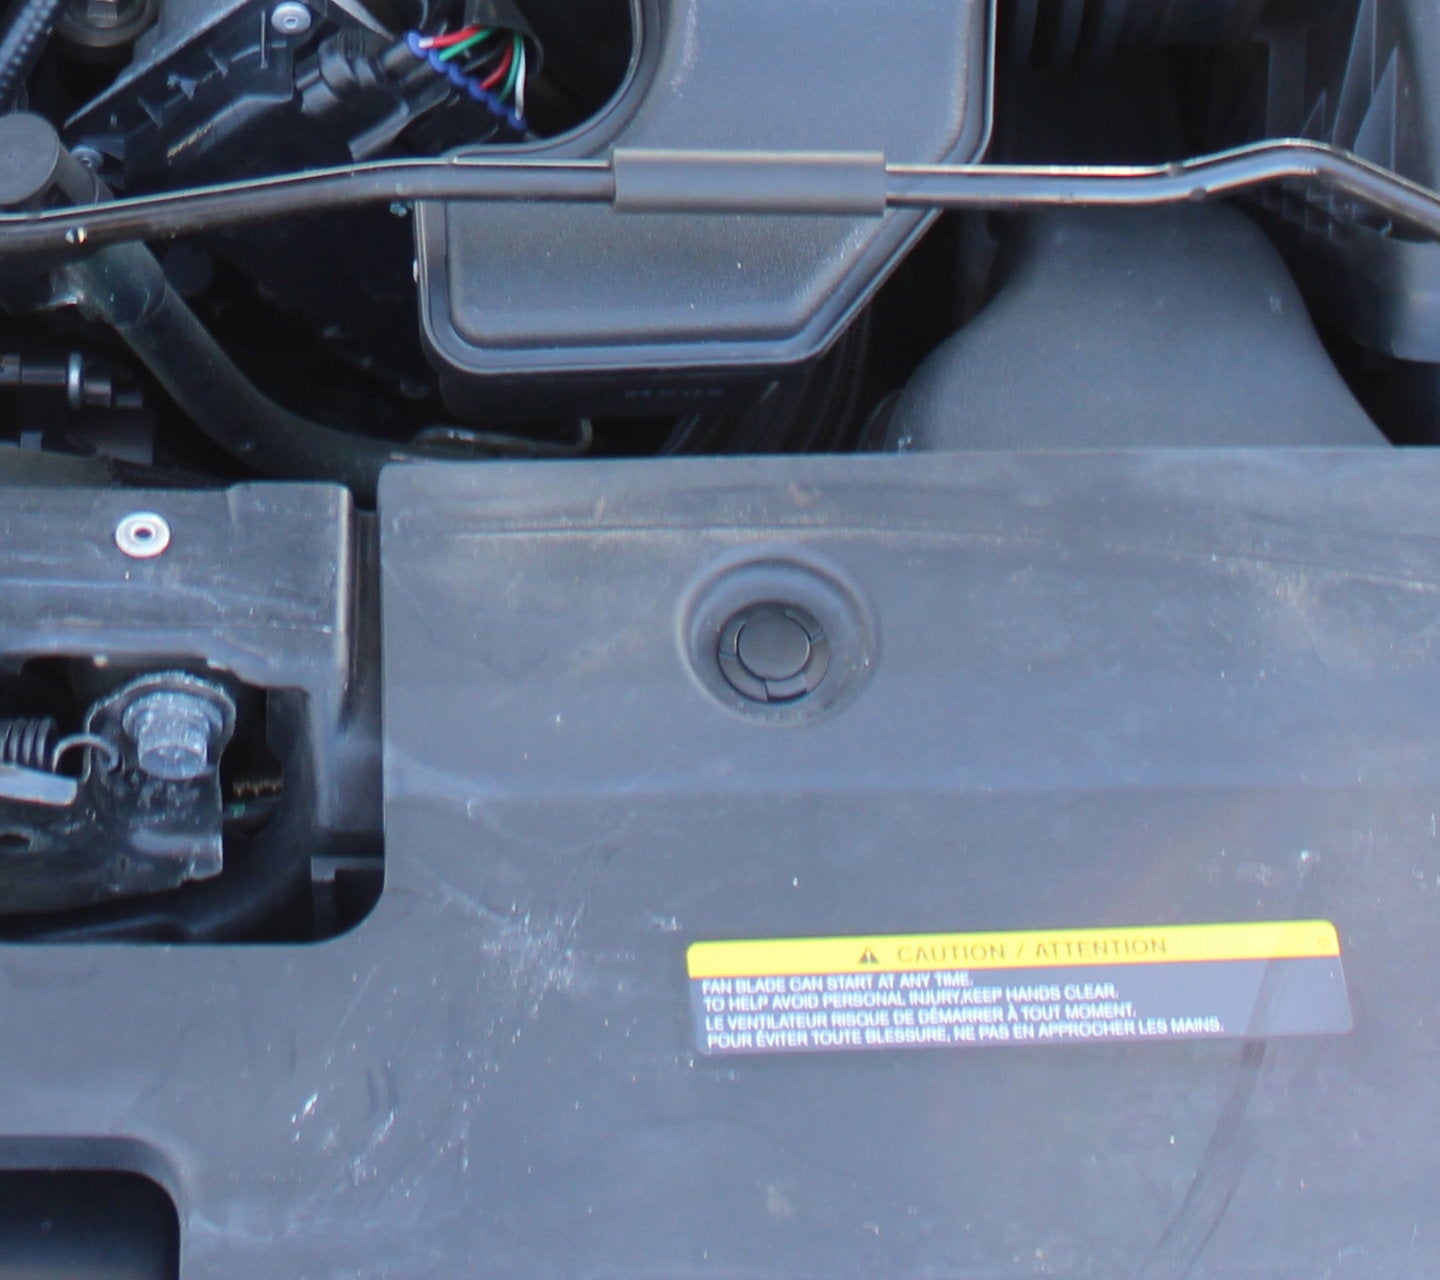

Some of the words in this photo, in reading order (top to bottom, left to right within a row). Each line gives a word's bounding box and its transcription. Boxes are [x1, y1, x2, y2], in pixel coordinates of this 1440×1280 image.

[897, 943, 1005, 963] CAUTION
[1036, 937, 1167, 958] ATTENTION
[702, 978, 732, 994] FAN
[735, 976, 786, 994] BLADE
[789, 975, 823, 992] CAN
[826, 973, 873, 991] START
[877, 973, 895, 989] AT
[899, 971, 930, 989] ANY
[933, 970, 974, 987] TIME.
[703, 995, 725, 1012] TO
[728, 993, 769, 1011] HELP
[772, 992, 819, 1010] AVOID
[822, 989, 906, 1009] PERSONAL
[1005, 984, 1060, 1002] HANDS
[1063, 981, 1119, 1000] CLEAR.
[705, 1014, 725, 1031] LE
[727, 1010, 828, 1031] VENTILATEUR
[831, 1008, 890, 1028] RISQUE
[893, 1008, 915, 1026] DE
[918, 1004, 1003, 1026] DÉMARRER
[1007, 1001, 1019, 1022] À
[1021, 1003, 1060, 1021] TOUT
[1064, 1000, 1137, 1020] MOMENT.
[707, 1031, 752, 1049] POUR
[756, 1028, 808, 1048] ÉVITER
[811, 1027, 862, 1046] TOUTE
[865, 1024, 951, 1044] BLESSURE,
[953, 1024, 976, 1041] NE
[978, 1023, 1010, 1040] PAS
[1013, 1022, 1034, 1039] EN
[1038, 1018, 1136, 1038] APPROCHER
[1138, 1017, 1168, 1035] LES
[1170, 1015, 1225, 1034] MAINS.
